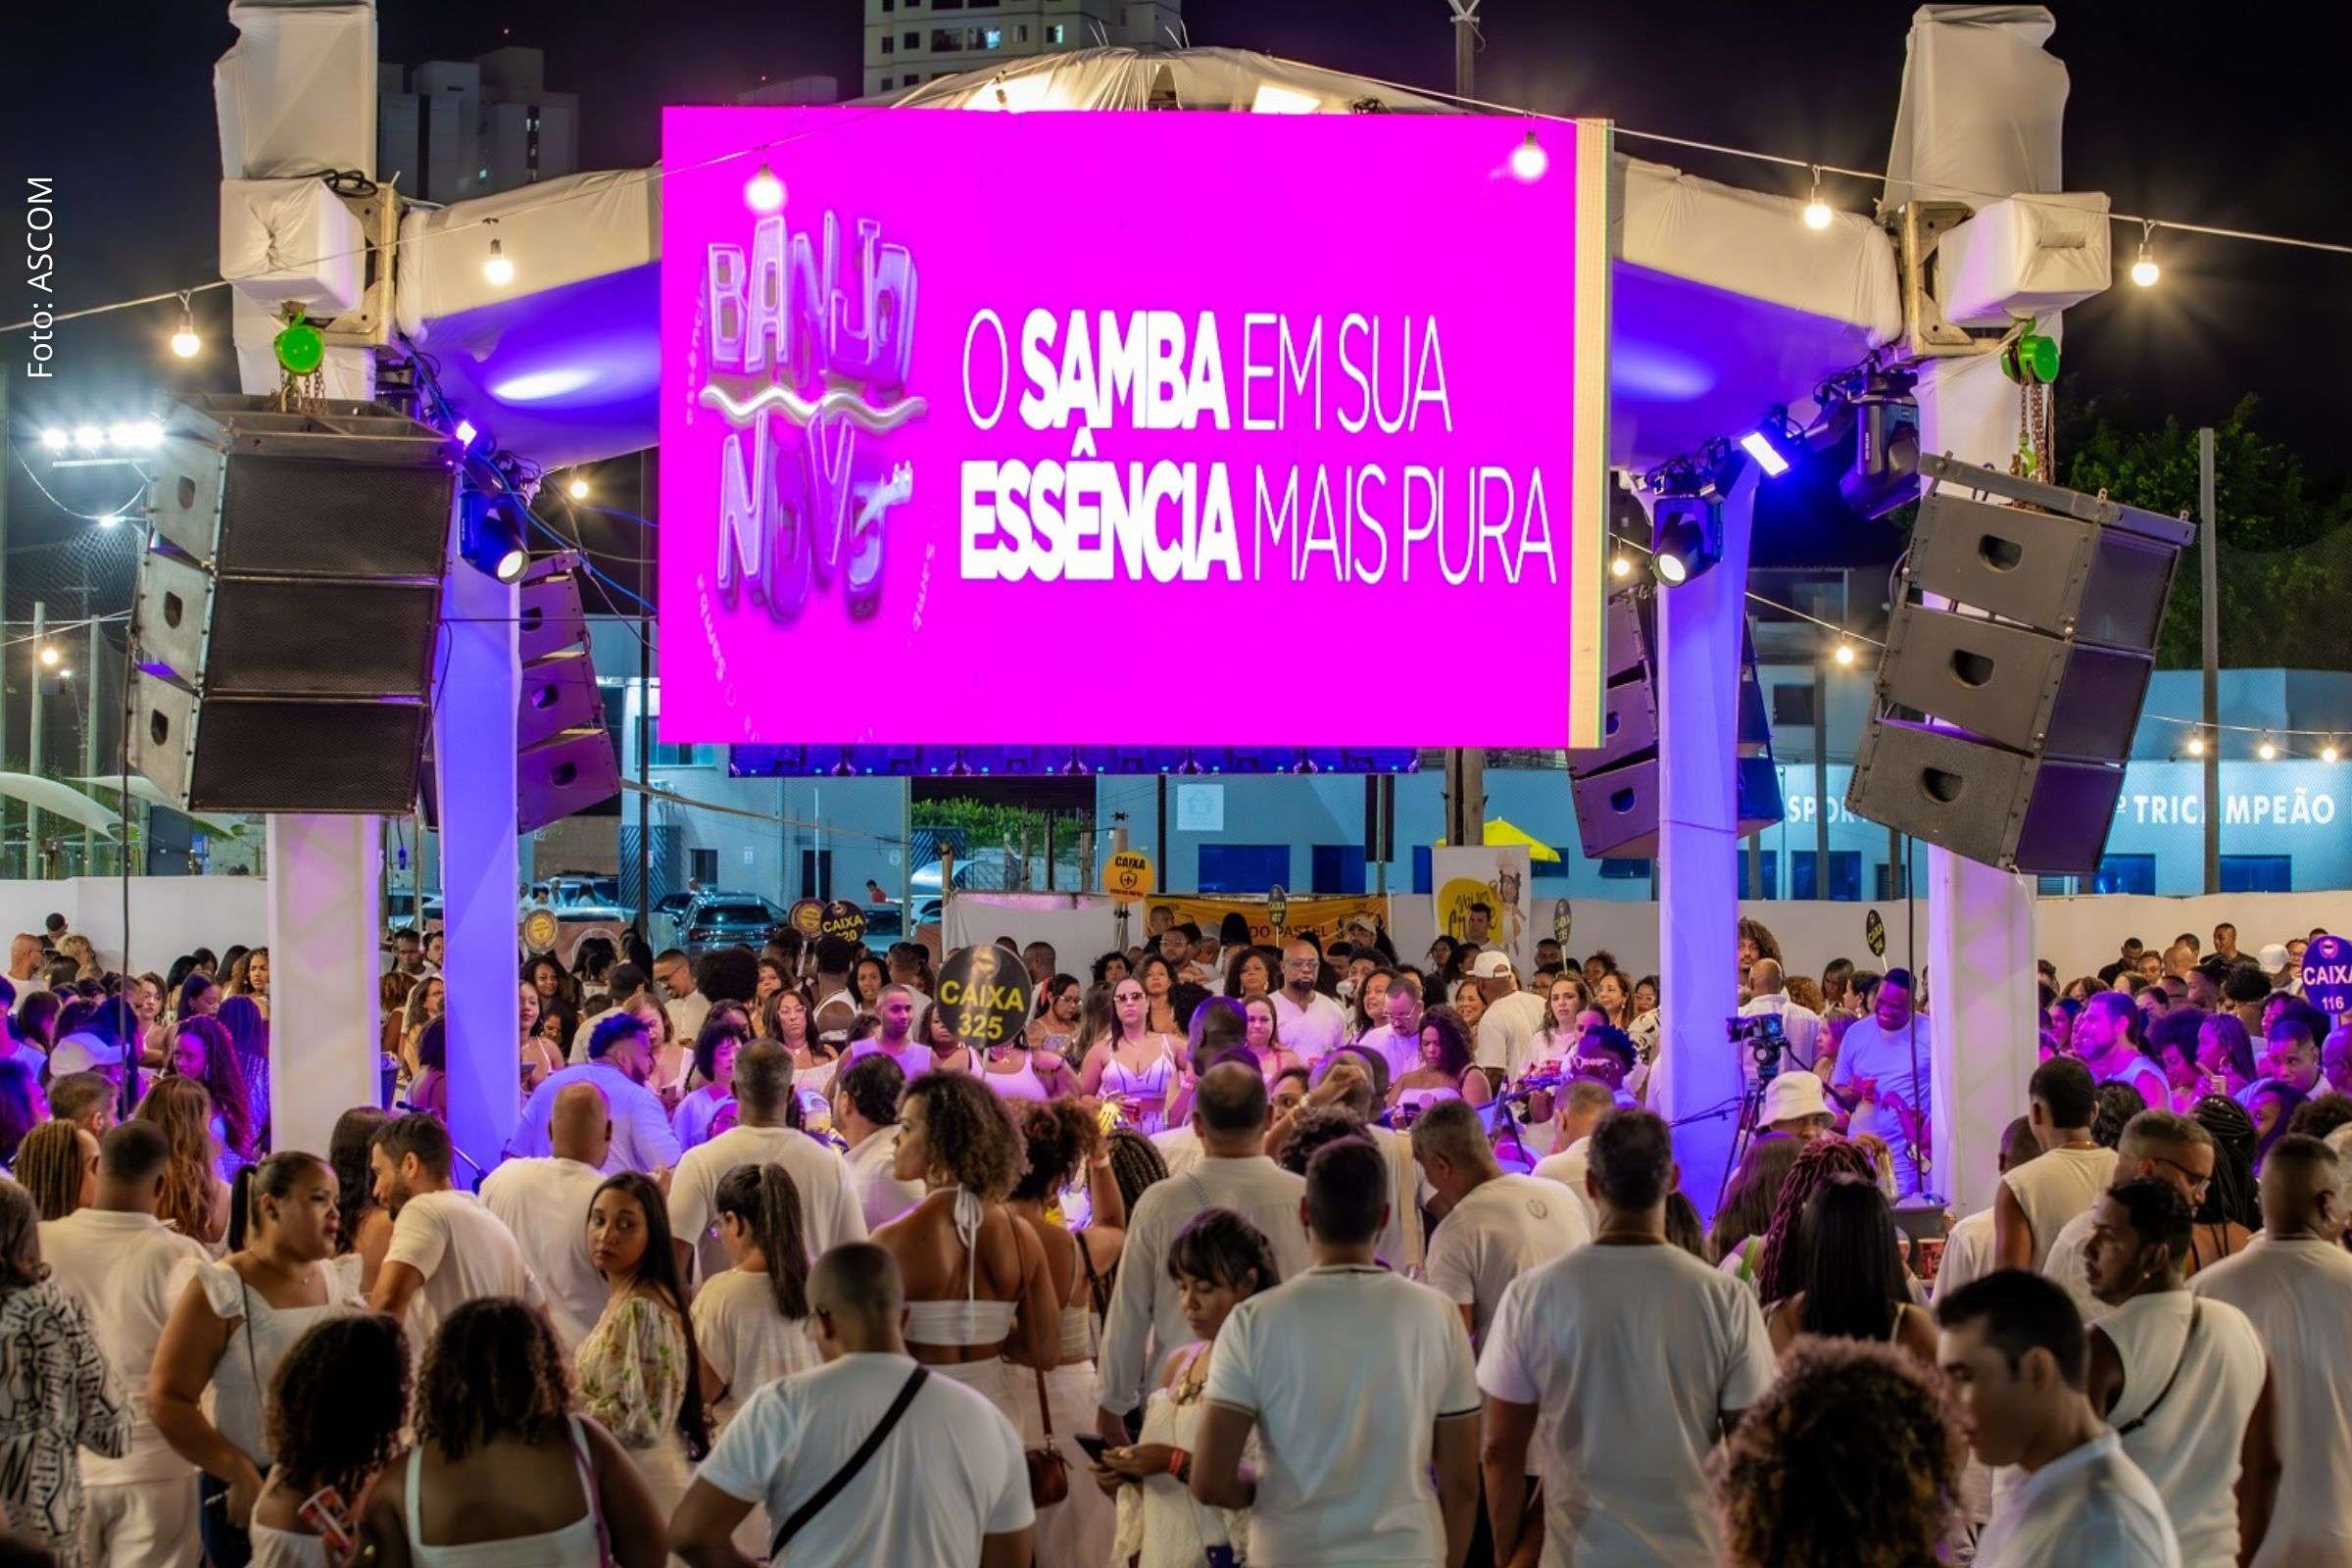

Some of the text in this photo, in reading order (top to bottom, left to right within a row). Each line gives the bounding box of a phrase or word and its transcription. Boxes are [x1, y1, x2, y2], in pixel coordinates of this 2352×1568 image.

[962, 308, 1453, 434] O SAMBA EM SUA
[960, 425, 1557, 586] ESSÊNCIA MAIS PURA
[2132, 786, 2336, 825] TRICMPEÃO
[1114, 856, 1146, 871] CAIXA
[822, 914, 864, 933] CAIXA
[836, 929, 858, 943] 20
[2303, 964, 2352, 986] CAIX
[940, 980, 1025, 1012] CAIXA
[2321, 995, 2345, 1011] 116
[957, 1012, 1004, 1040] 325
